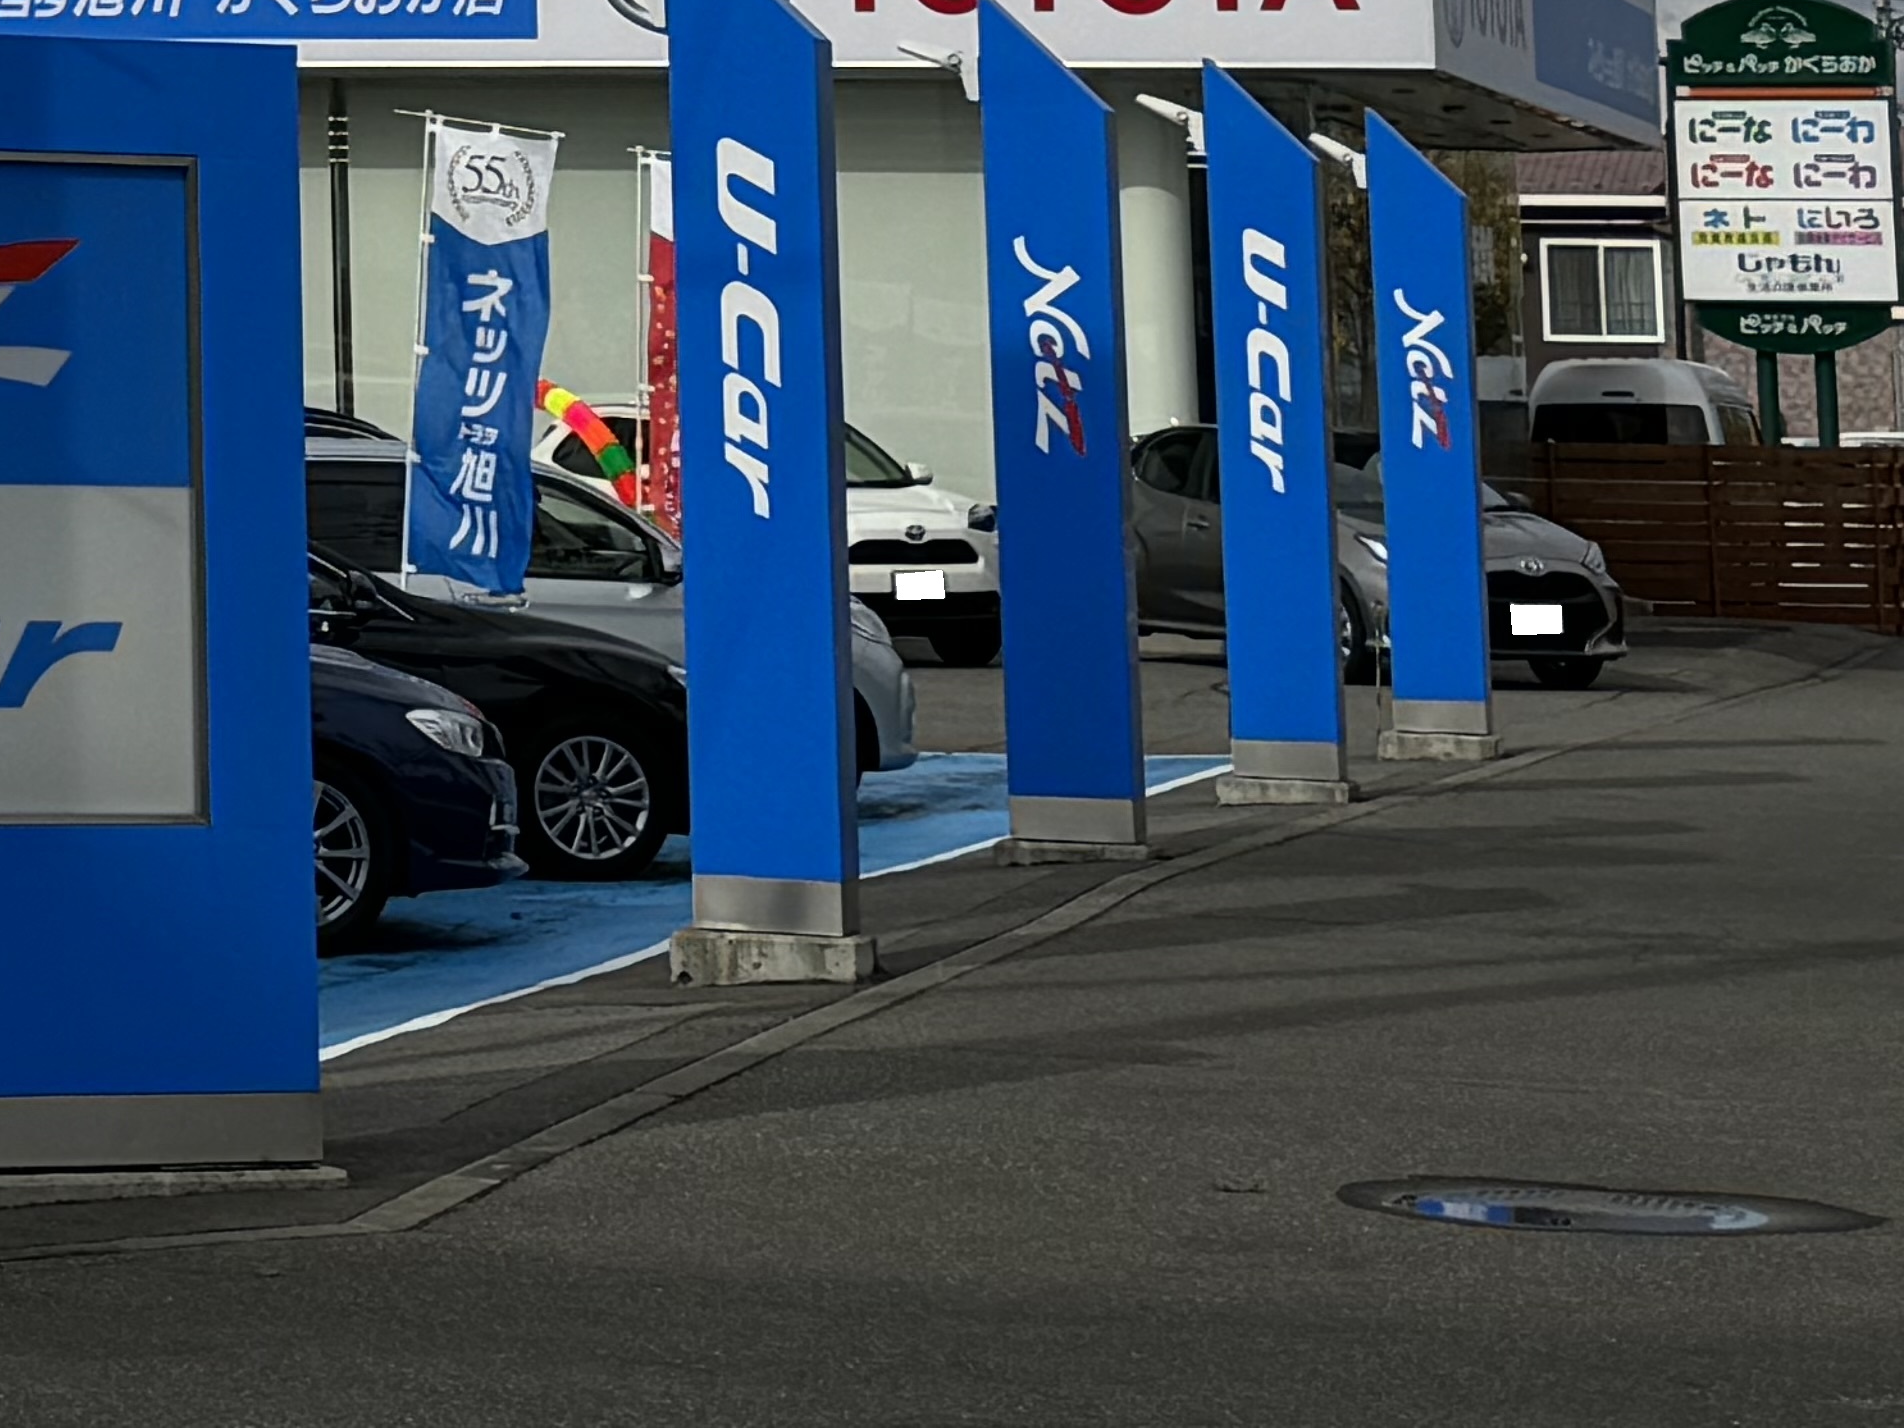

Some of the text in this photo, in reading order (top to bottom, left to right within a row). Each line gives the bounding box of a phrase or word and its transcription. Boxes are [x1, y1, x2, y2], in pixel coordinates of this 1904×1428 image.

[717, 137, 781, 519] U-Car
[1013, 235, 1090, 457] Netz
[1242, 228, 1291, 494] U-Car
[1393, 288, 1452, 451] Netz
